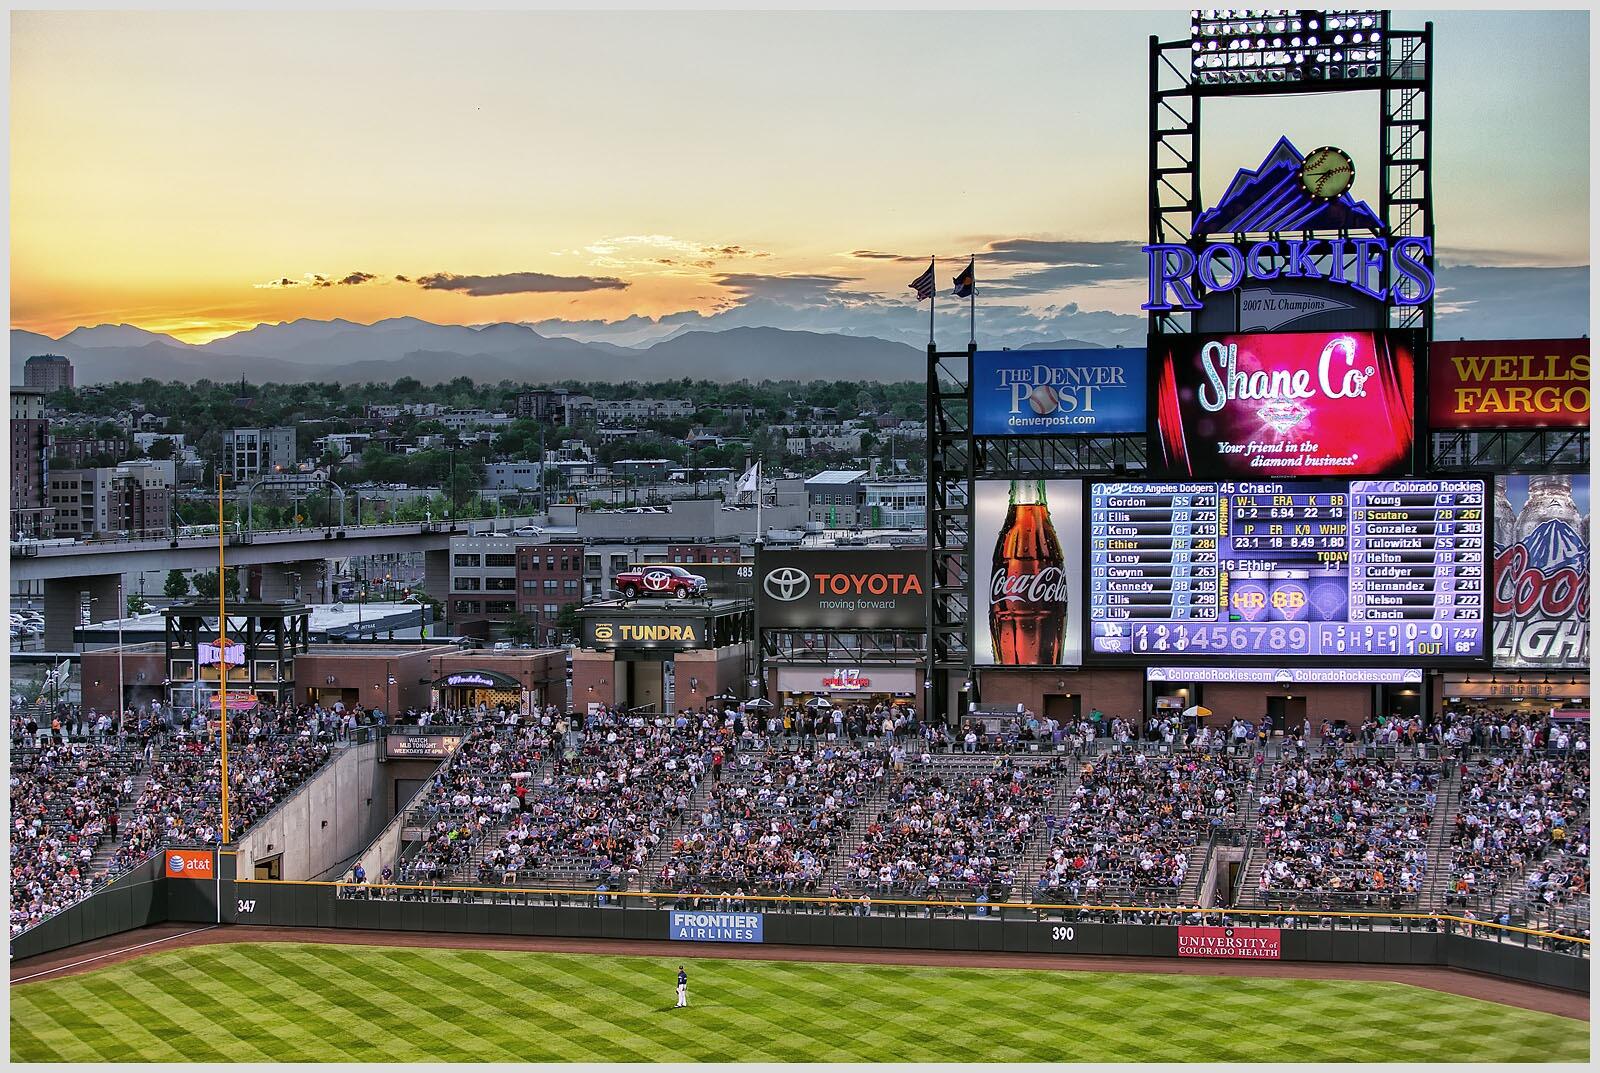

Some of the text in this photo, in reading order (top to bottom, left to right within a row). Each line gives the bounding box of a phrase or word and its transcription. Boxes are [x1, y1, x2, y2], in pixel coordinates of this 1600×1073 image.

[1140, 235, 1436, 311] ROCKIES
[1242, 298, 1325, 312] 2007 NL Champions
[1450, 354, 1590, 382] WELLS
[996, 364, 1127, 387] THE DENVER
[1199, 340, 1316, 412] Shane
[1008, 382, 1100, 416] POST
[1454, 386, 1590, 414] FARGO
[1008, 414, 1096, 428] denverpost.com
[1217, 442, 1318, 454] Your friend in the
[1250, 454, 1302, 467] diamond
[1128, 484, 1144, 493] Los
[1144, 484, 1178, 494] Angeles
[1180, 484, 1214, 494] Dodgers
[1220, 483, 1283, 494] 45 Chacin
[1393, 482, 1482, 492] Colorado Rockies
[1108, 497, 1215, 506] Gordon SS .211
[1237, 496, 1344, 506] W-L ERA K BB
[1367, 495, 1481, 506] Young CF .263
[1108, 512, 1215, 521] Ellis 2B .275
[1220, 498, 1228, 536] PITCHING
[1237, 508, 1342, 518] 0-2 6.94 22 13
[1367, 510, 1481, 519] Scutaro 2B .267
[1108, 526, 1215, 536] Kemp CF .419
[1245, 525, 1347, 536] IP ER K/9 WHIP
[1367, 524, 1481, 533] Gonzalez LF .303
[1108, 540, 1215, 549] Ethier RF .284
[1236, 538, 1344, 547] 23.1 18 8.49 1.80
[1367, 538, 1481, 547] Tulowitzki SS .279
[1108, 554, 1215, 564] Loney 1B .225
[1317, 552, 1349, 561] TODAY
[1353, 553, 1481, 562] 17 Helton 1B .250
[1220, 560, 1340, 570] 16 Ethier 1-1
[737, 566, 753, 578] 485
[1094, 568, 1215, 579] 10 Gwynn LF .263
[1367, 567, 1481, 578] Cuddyer RF .295
[814, 573, 923, 595] TOYOTA
[990, 566, 1068, 604] Coca-Cola
[1108, 582, 1215, 593] Kennedy 3B .105
[1220, 572, 1229, 607] BATTING
[1352, 581, 1479, 590] 55 Hernandez C .241
[819, 599, 896, 610] moving forward
[1094, 595, 1215, 604] 17 Ellis C .298
[1234, 591, 1304, 608] HR BB
[1352, 595, 1479, 604] 10 Nelson 3B .222
[1093, 608, 1215, 619] 29 Lilly P .143
[1352, 610, 1478, 619] 45 Chacin P .375
[619, 625, 696, 641] TUNDRA
[1337, 626, 1398, 637] 5 9 0
[1453, 628, 1478, 638] 7:47
[1323, 632, 1386, 646] R H E
[1493, 621, 1590, 661] LIGH
[1337, 640, 1345, 651] 0
[1406, 641, 1443, 654] 1 OUT
[1168, 670, 1401, 681] ColoradoRockies.com ColoradoRockies.com
[186, 859, 210, 870] at&t
[238, 900, 256, 913] 347
[674, 914, 758, 928] FRONTIER
[680, 928, 753, 939] AIRLINES
[1052, 926, 1074, 941] 390
[1179, 936, 1267, 949] UNIVERSITY
[1179, 947, 1278, 957] COLORADO HEALTH
